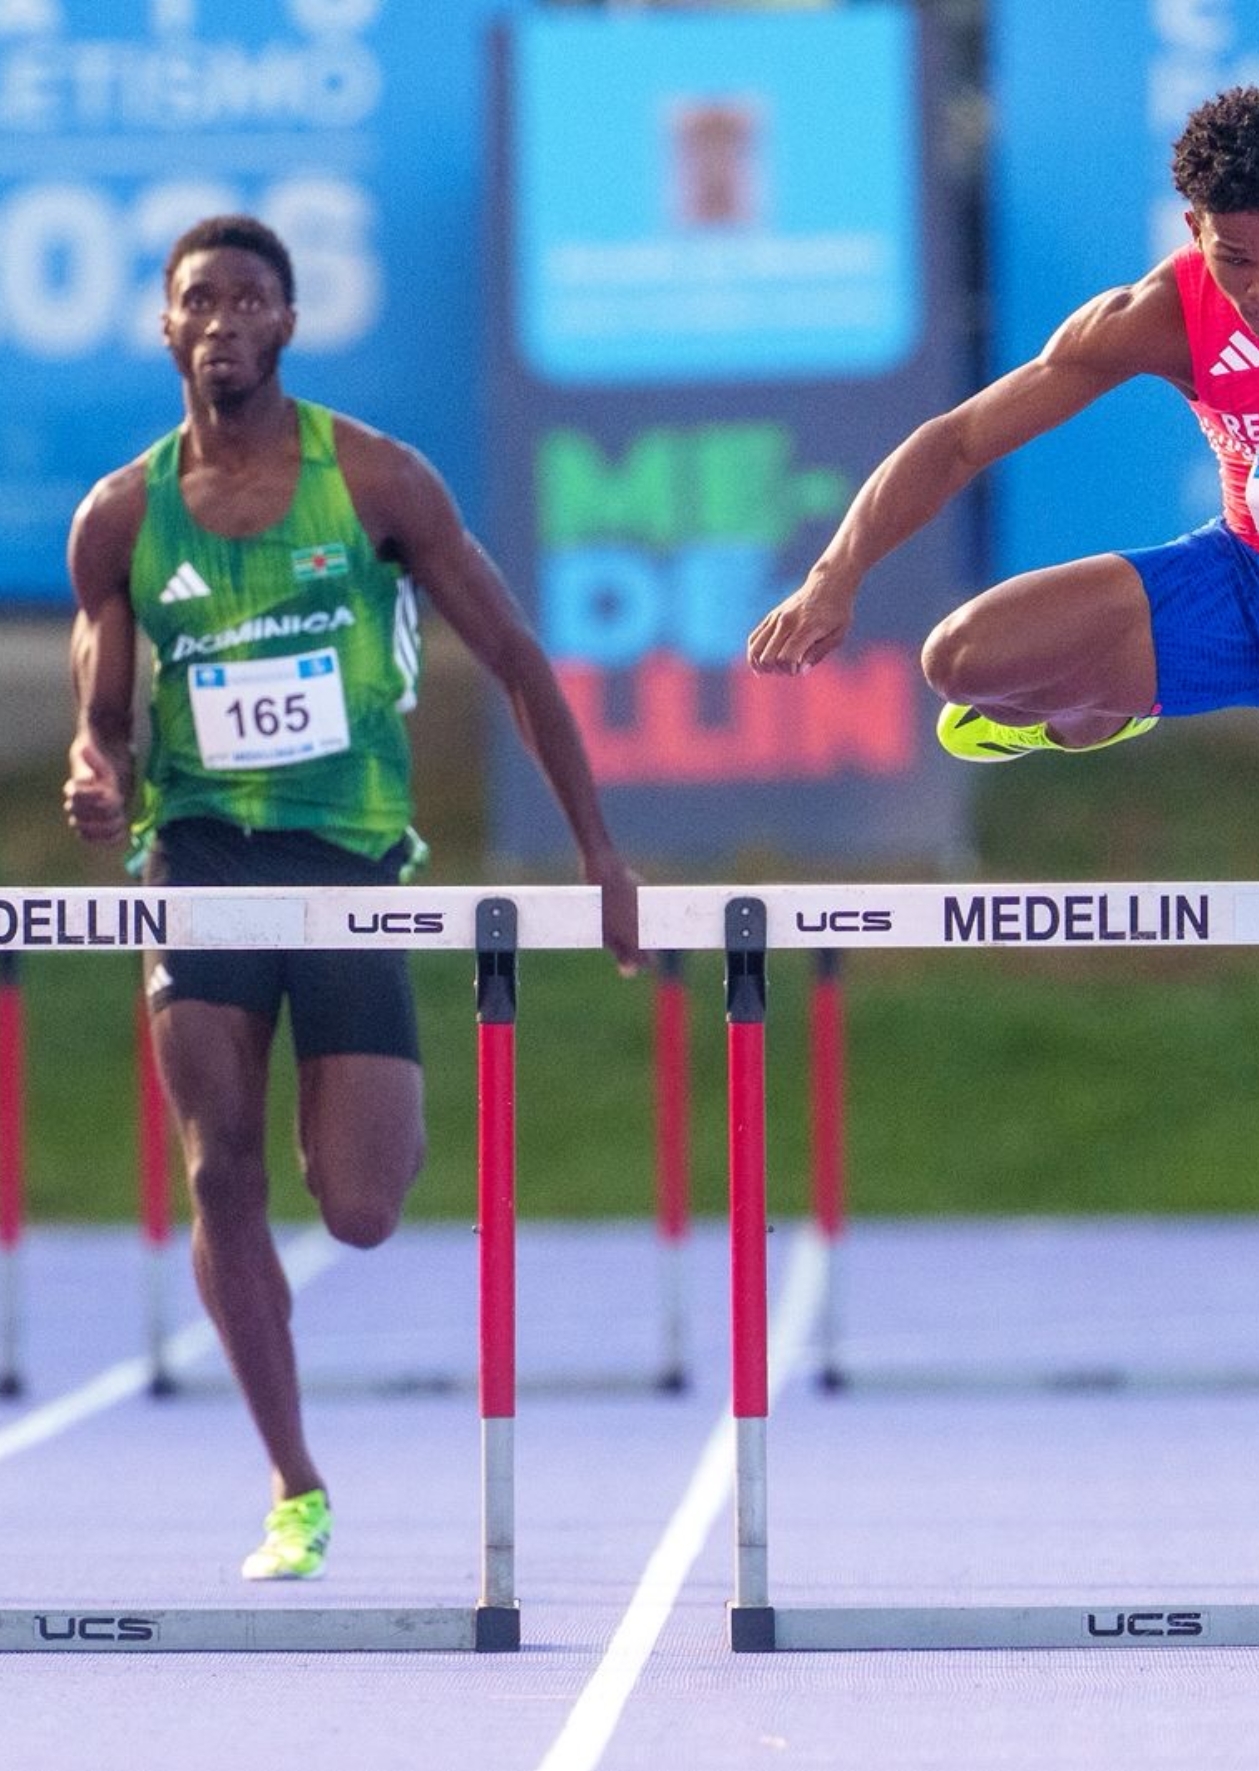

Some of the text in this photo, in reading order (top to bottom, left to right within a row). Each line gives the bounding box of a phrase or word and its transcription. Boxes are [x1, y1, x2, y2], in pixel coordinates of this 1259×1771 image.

[172, 605, 355, 662] DOMINICA
[226, 692, 310, 739] 165
[348, 912, 444, 934] UCS
[796, 894, 1209, 942] UCS MEDELLIN
[38, 1616, 154, 1641] UCS
[1087, 1612, 1203, 1637] UCS
